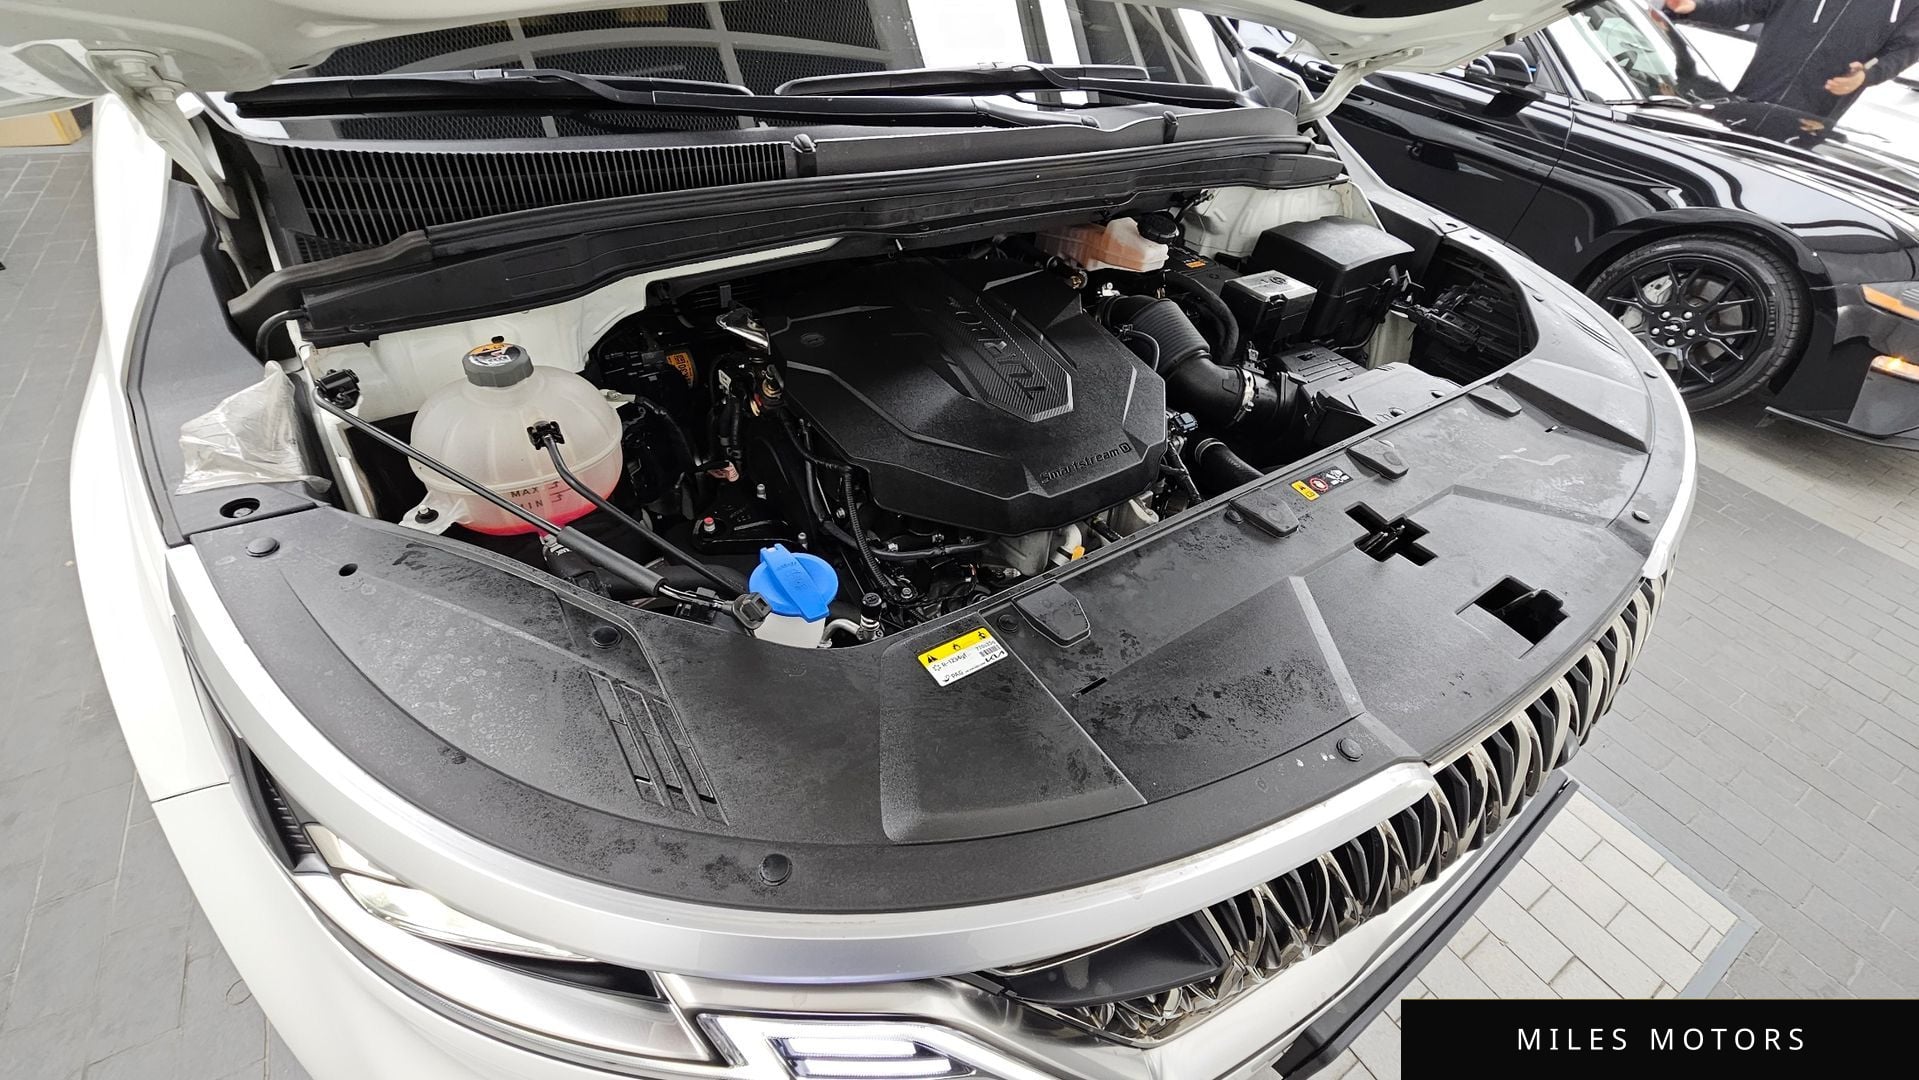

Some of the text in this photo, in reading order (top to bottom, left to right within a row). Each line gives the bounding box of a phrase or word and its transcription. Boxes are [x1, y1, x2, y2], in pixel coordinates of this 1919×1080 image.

[1040, 446, 1120, 483] Smartstream
[510, 486, 539, 498] MAX
[520, 499, 544, 510] IN
